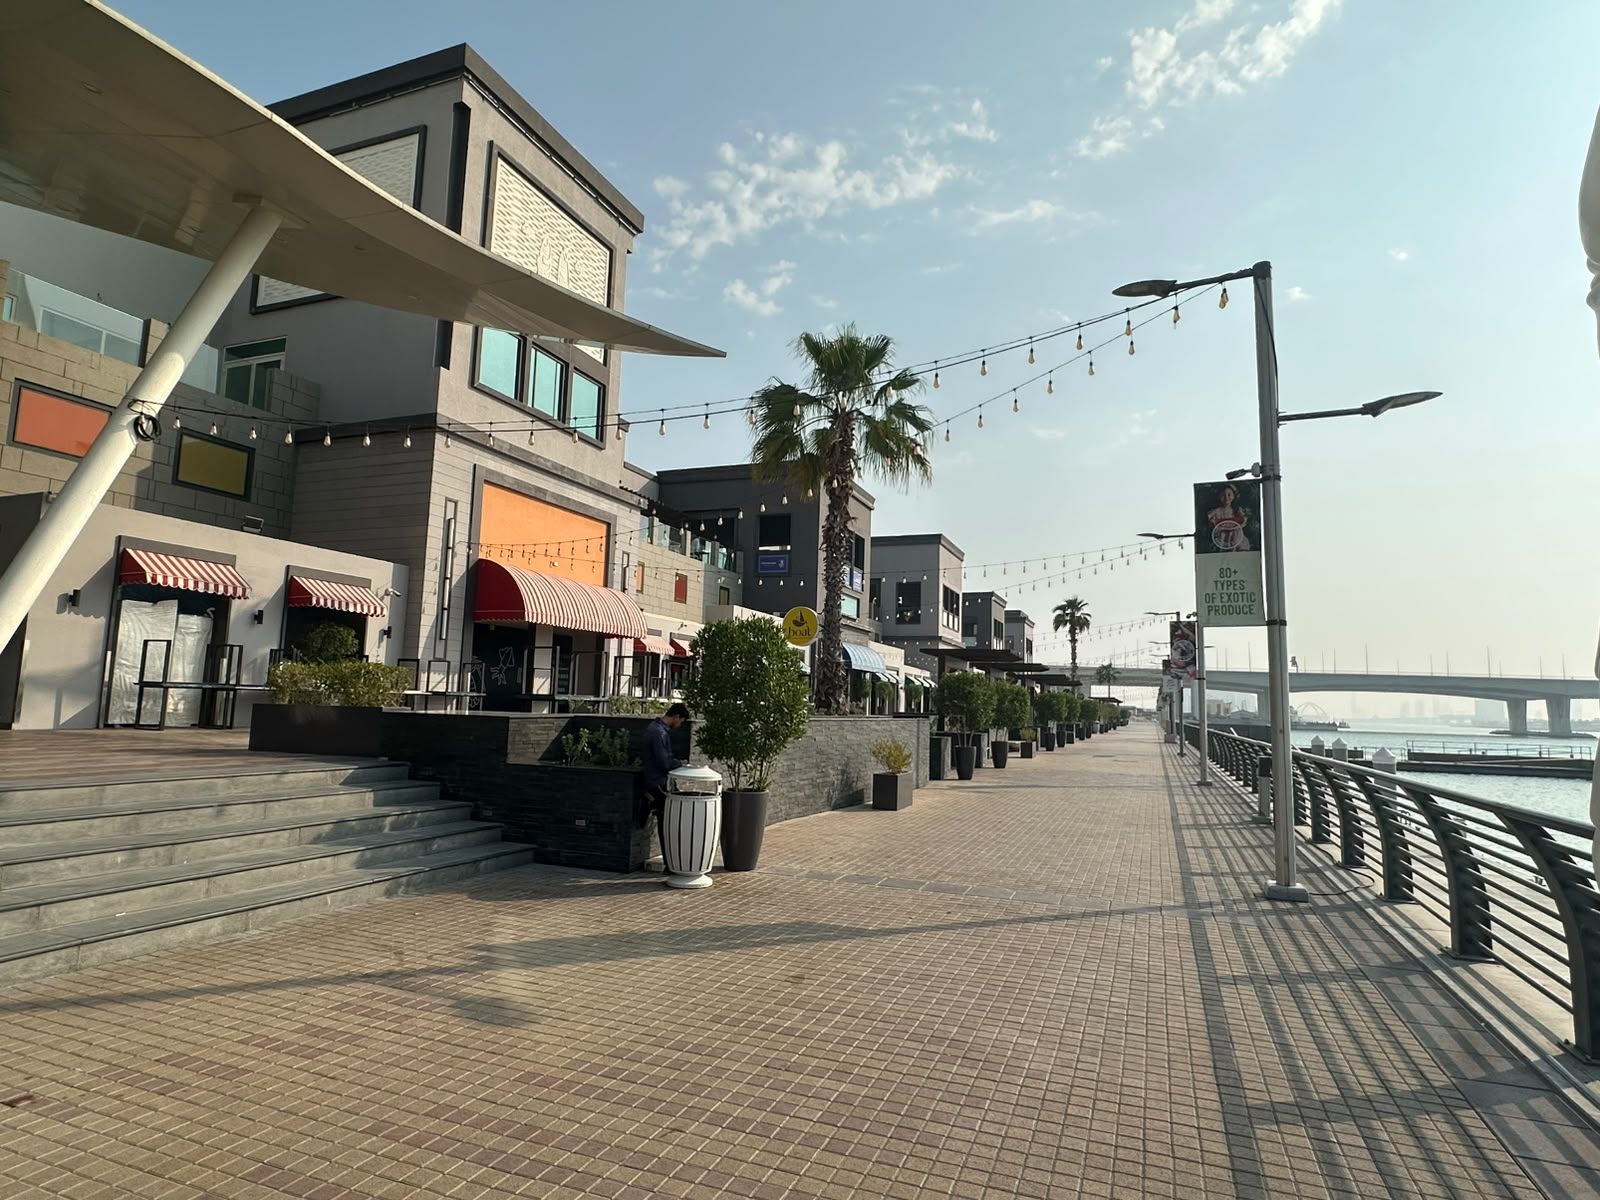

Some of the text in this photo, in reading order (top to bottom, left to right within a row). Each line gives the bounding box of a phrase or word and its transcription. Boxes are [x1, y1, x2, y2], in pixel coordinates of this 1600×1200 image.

[1219, 567, 1238, 579] 80+
[1213, 579, 1246, 591] TYPES
[1204, 591, 1256, 604] OF EXOTIC
[1207, 604, 1255, 616] PRODUCE
